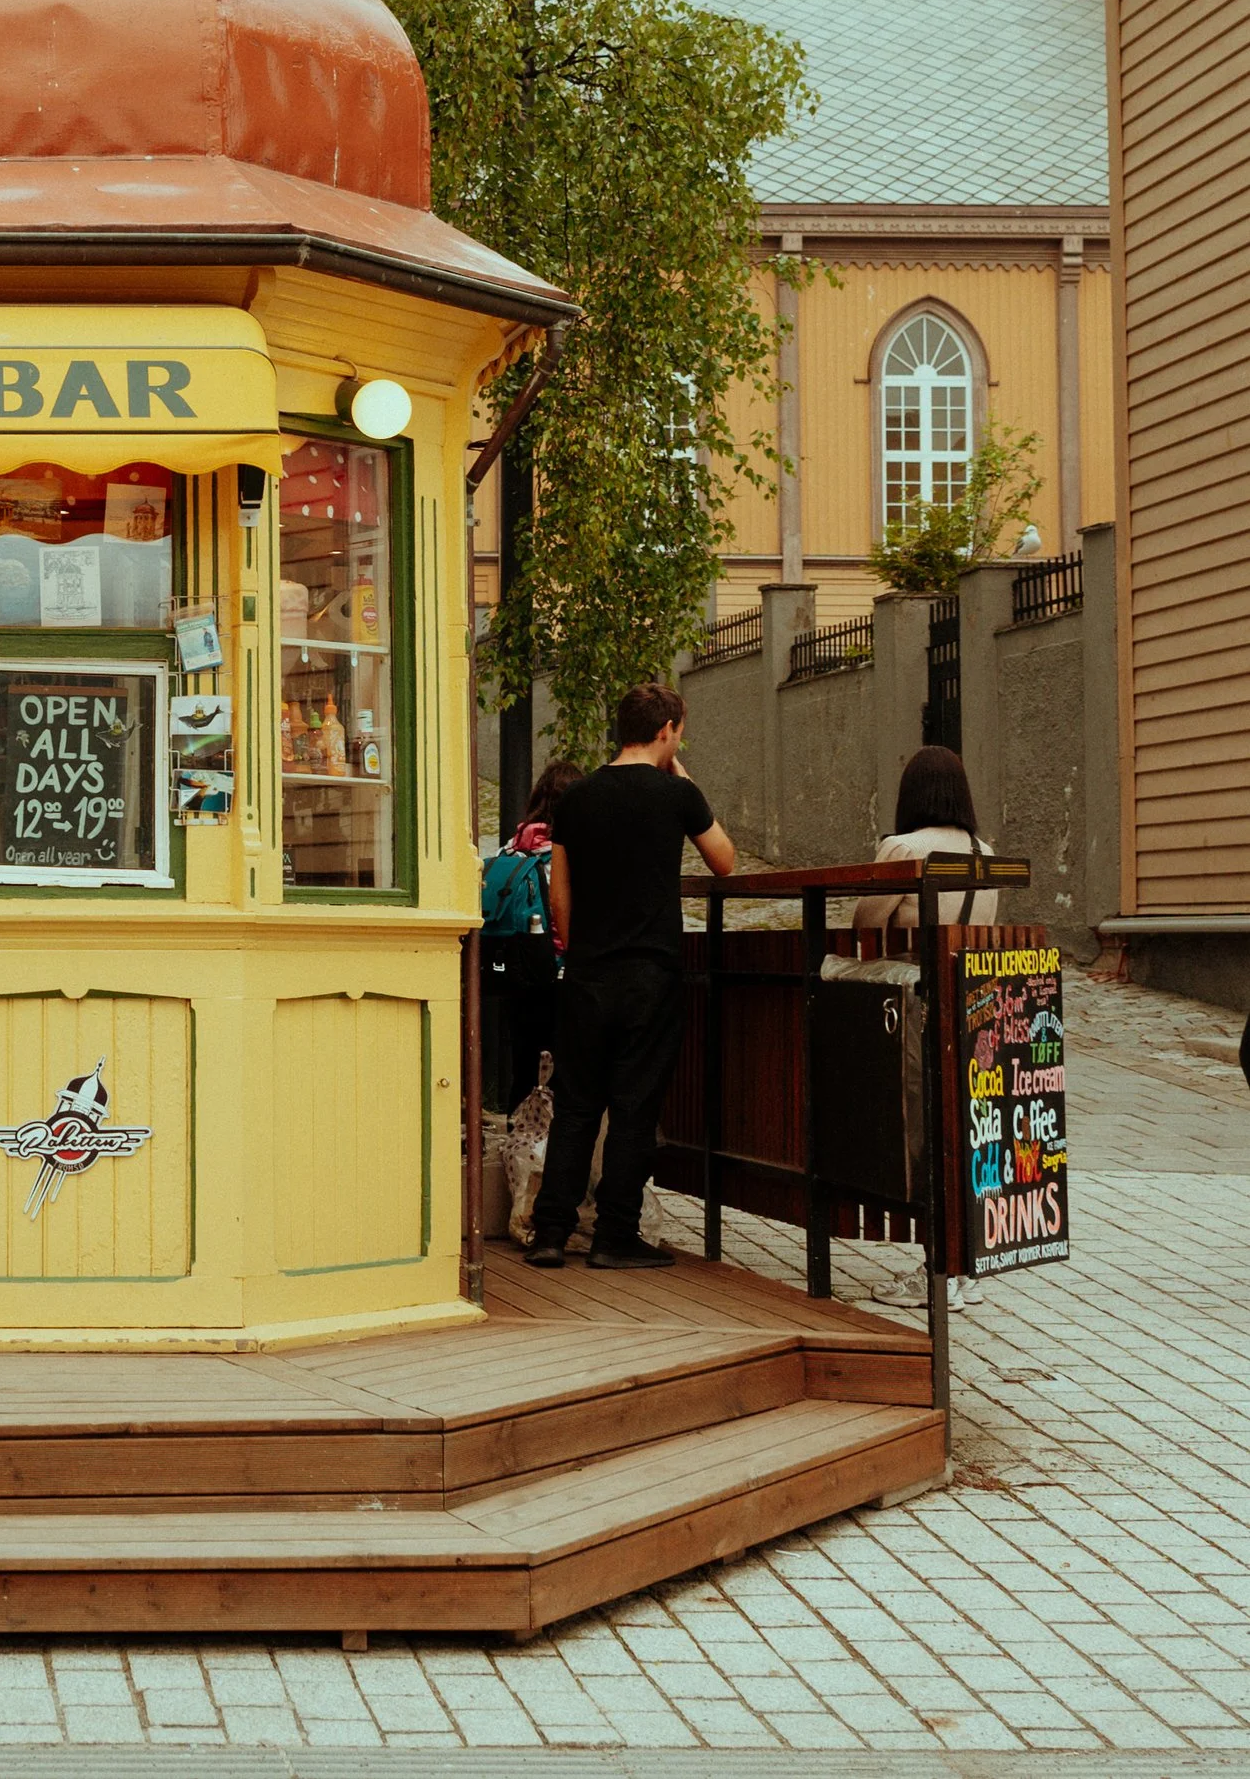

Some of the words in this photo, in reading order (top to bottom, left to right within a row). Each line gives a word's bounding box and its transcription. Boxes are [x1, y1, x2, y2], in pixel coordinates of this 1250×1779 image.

[20, 695, 117, 727] OPEN
[30, 728, 97, 761] ALL
[16, 761, 104, 794] DAYS
[5, 845, 37, 864] Open
[37, 846, 55, 863] all
[56, 851, 92, 866] year
[965, 951, 994, 979] FULLY
[994, 949, 1039, 978] LICENSED
[1039, 947, 1061, 974] BAR
[988, 1019, 1001, 1052] of
[1003, 1014, 1031, 1044] bliss
[1030, 1041, 1061, 1063] TØFF
[968, 1058, 1005, 1099] Cocoa
[1011, 1058, 1032, 1097] Ice
[1032, 1065, 1066, 1095] cream
[17, 1120, 128, 1159] Raketten
[969, 1098, 1003, 1150] Soda
[971, 1142, 1003, 1198] Cold
[1004, 1148, 1014, 1185] &
[1042, 1150, 1067, 1173] Sangria
[984, 1181, 1061, 1249] DRINKS
[975, 1255, 990, 1274] SETT
